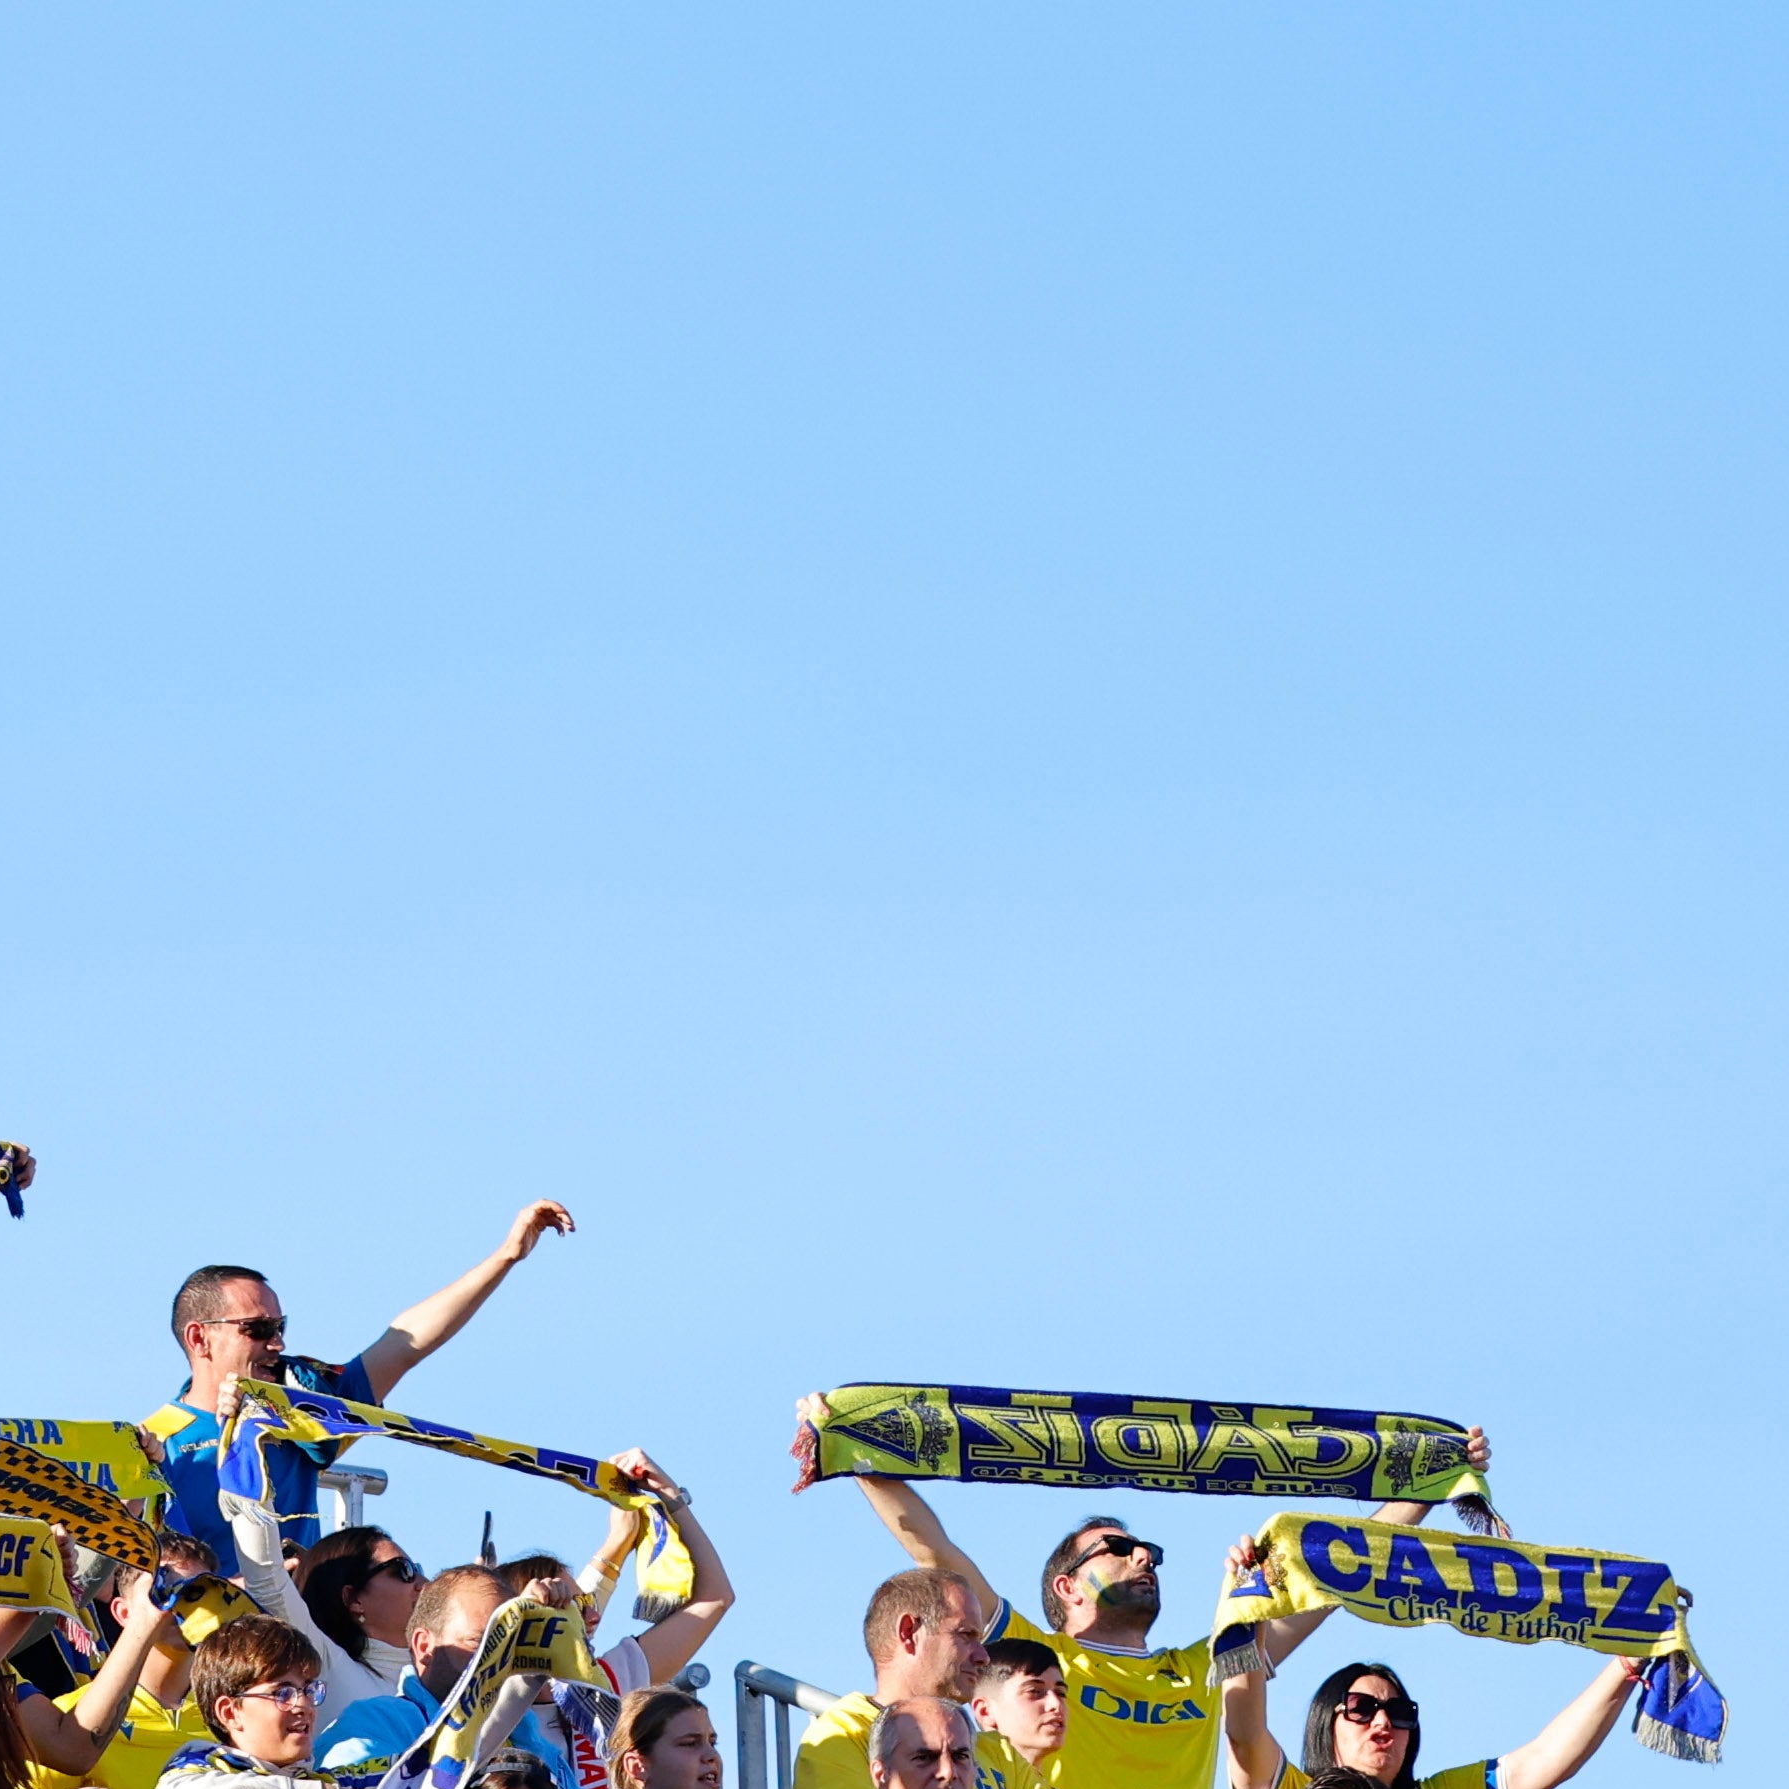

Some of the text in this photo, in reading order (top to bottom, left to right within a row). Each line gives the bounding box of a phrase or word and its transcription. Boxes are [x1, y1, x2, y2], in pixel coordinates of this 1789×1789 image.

[2, 1535, 35, 1577] CF
[1300, 1520, 1677, 1633] CADIZ
[1387, 1595, 1591, 1644] Club de Fútbol
